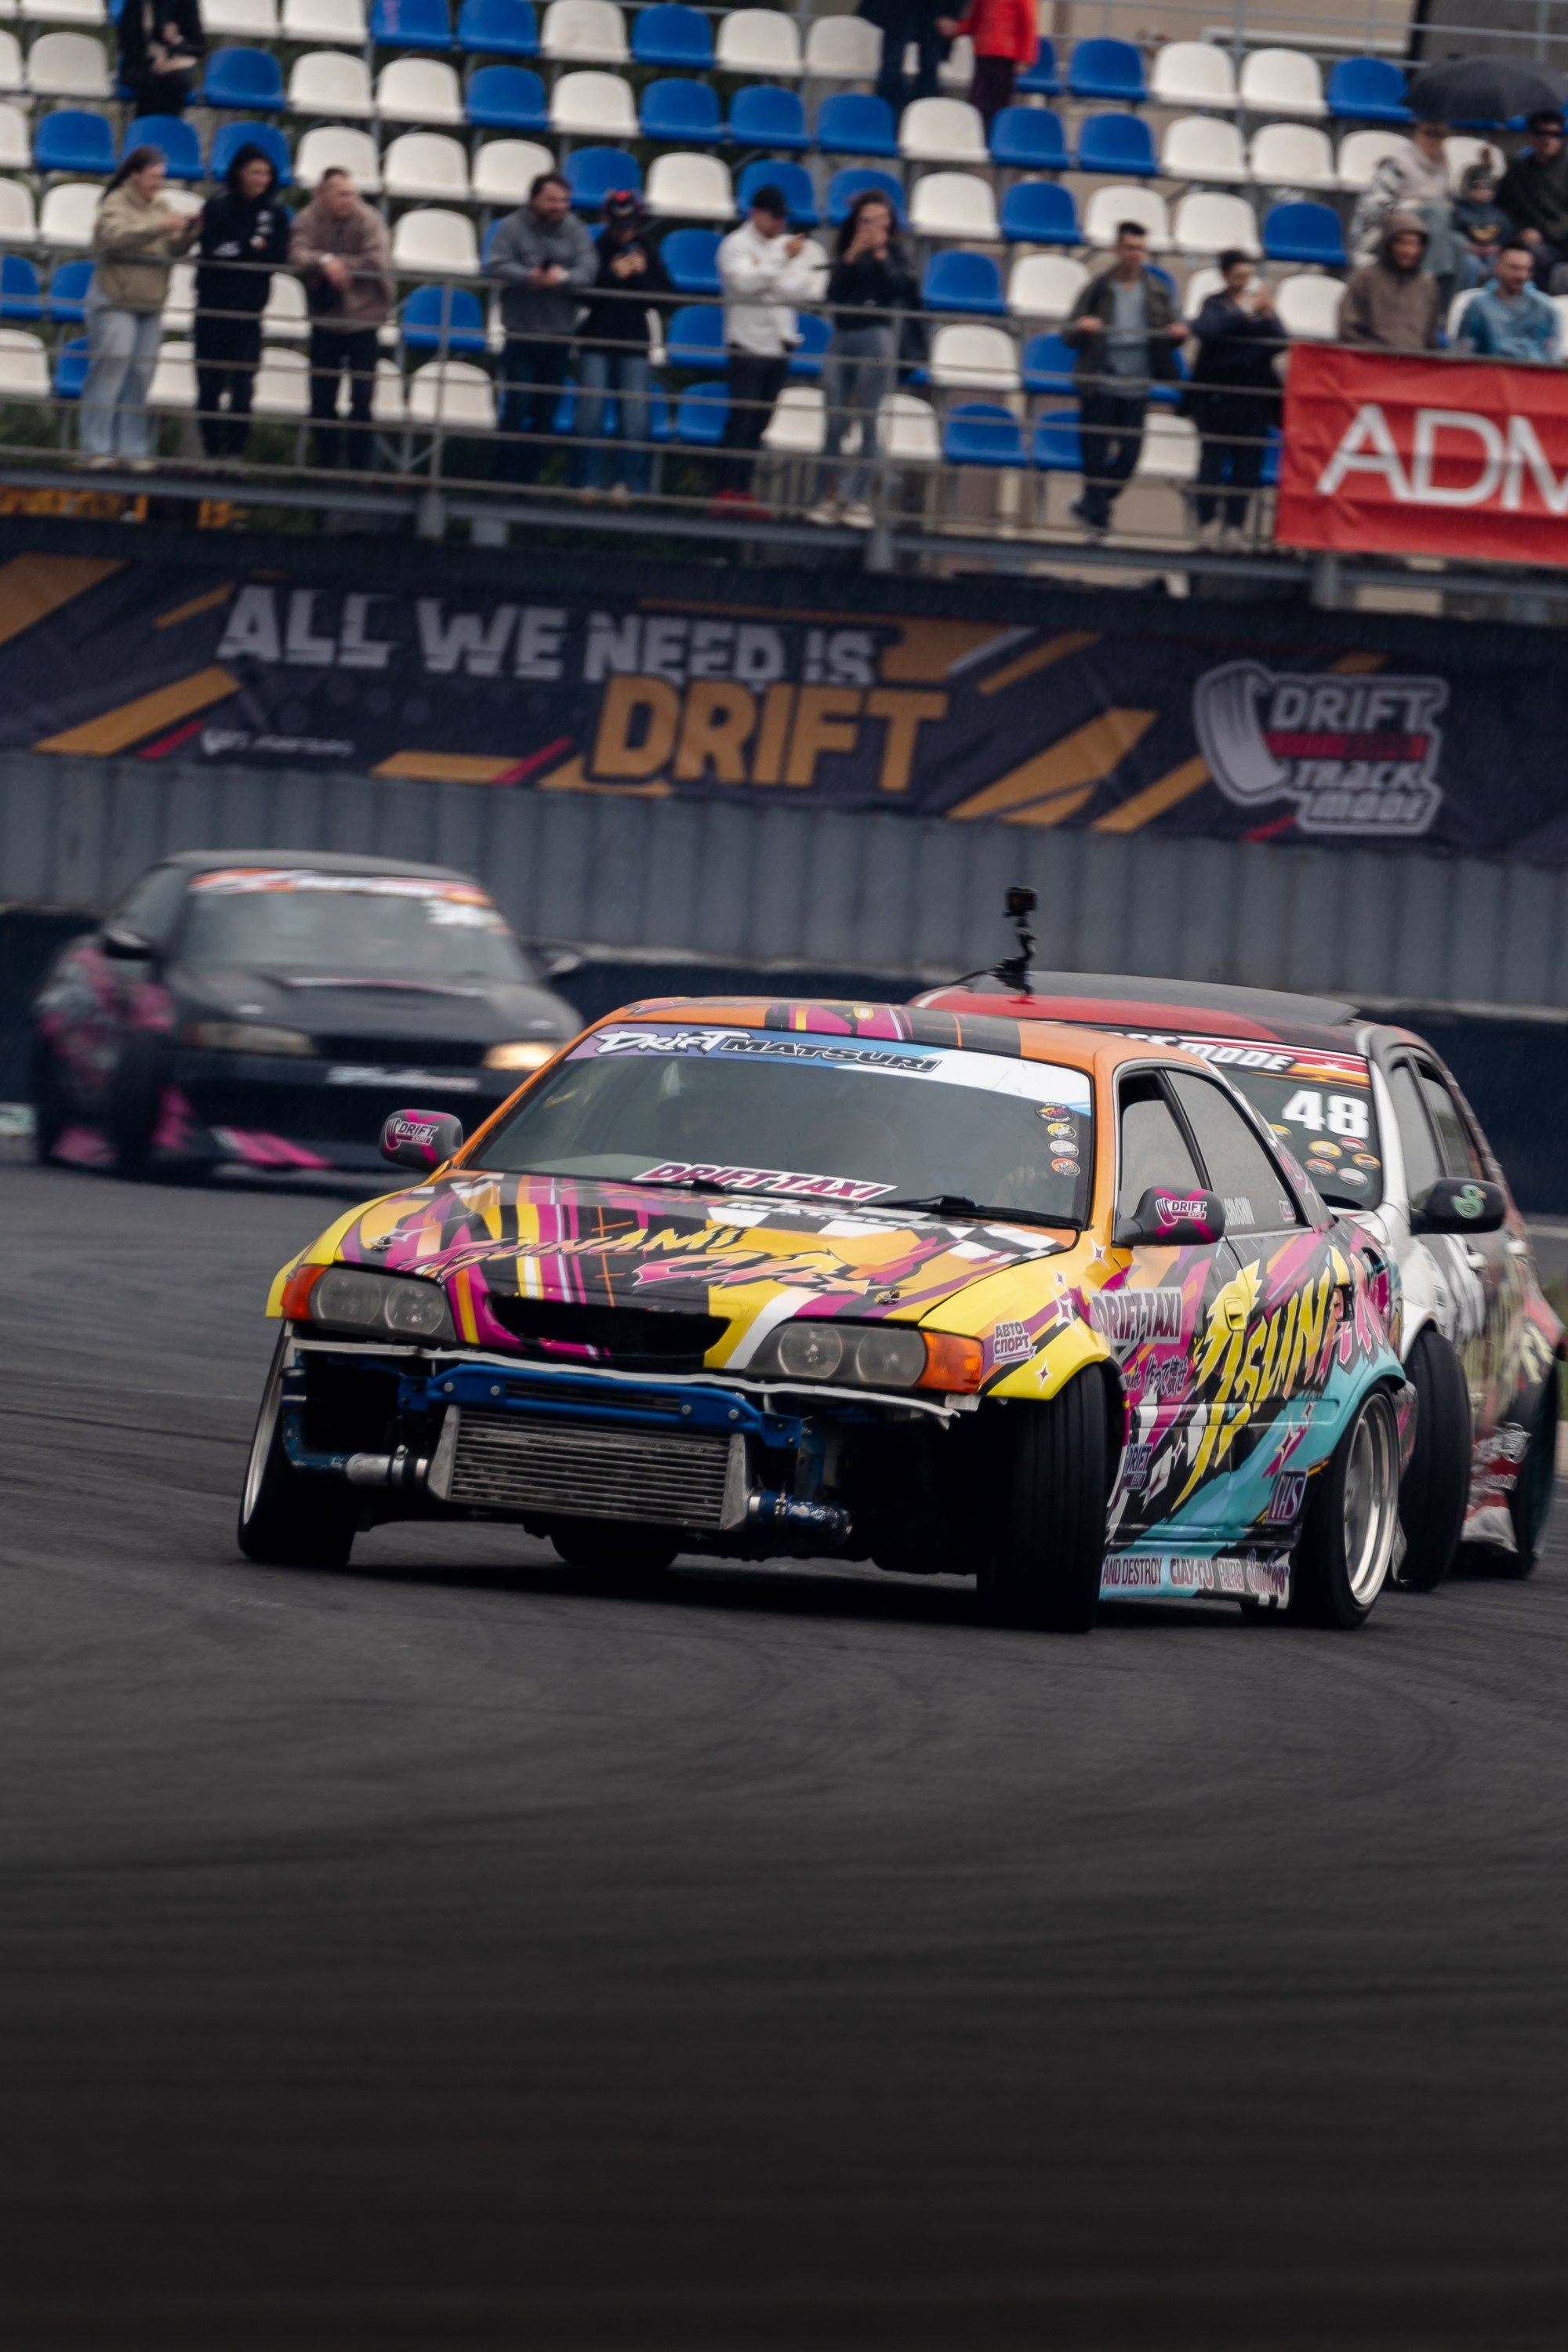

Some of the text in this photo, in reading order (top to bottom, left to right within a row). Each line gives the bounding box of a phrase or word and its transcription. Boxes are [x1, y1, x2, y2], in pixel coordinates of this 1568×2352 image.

[1316, 401, 1568, 515] ADM
[216, 584, 875, 690] ALL WE NEED IS
[1271, 685, 1436, 730] DRIFT
[591, 674, 949, 791] DRIFT
[719, 1037, 945, 1073] MATSURI
[397, 1122, 437, 1137] DRIFT
[1281, 1090, 1370, 1139] 48
[643, 1163, 890, 1199] DRIFT TAXI
[1171, 1200, 1206, 1211] DRIFT
[995, 1321, 1023, 1338] АВТО
[1092, 1291, 1182, 1340] DRIFT TAXI
[994, 1334, 1029, 1354] СПОРТ
[1271, 1475, 1305, 1519] VHS
[1102, 1557, 1163, 1585] AND DESTROY
